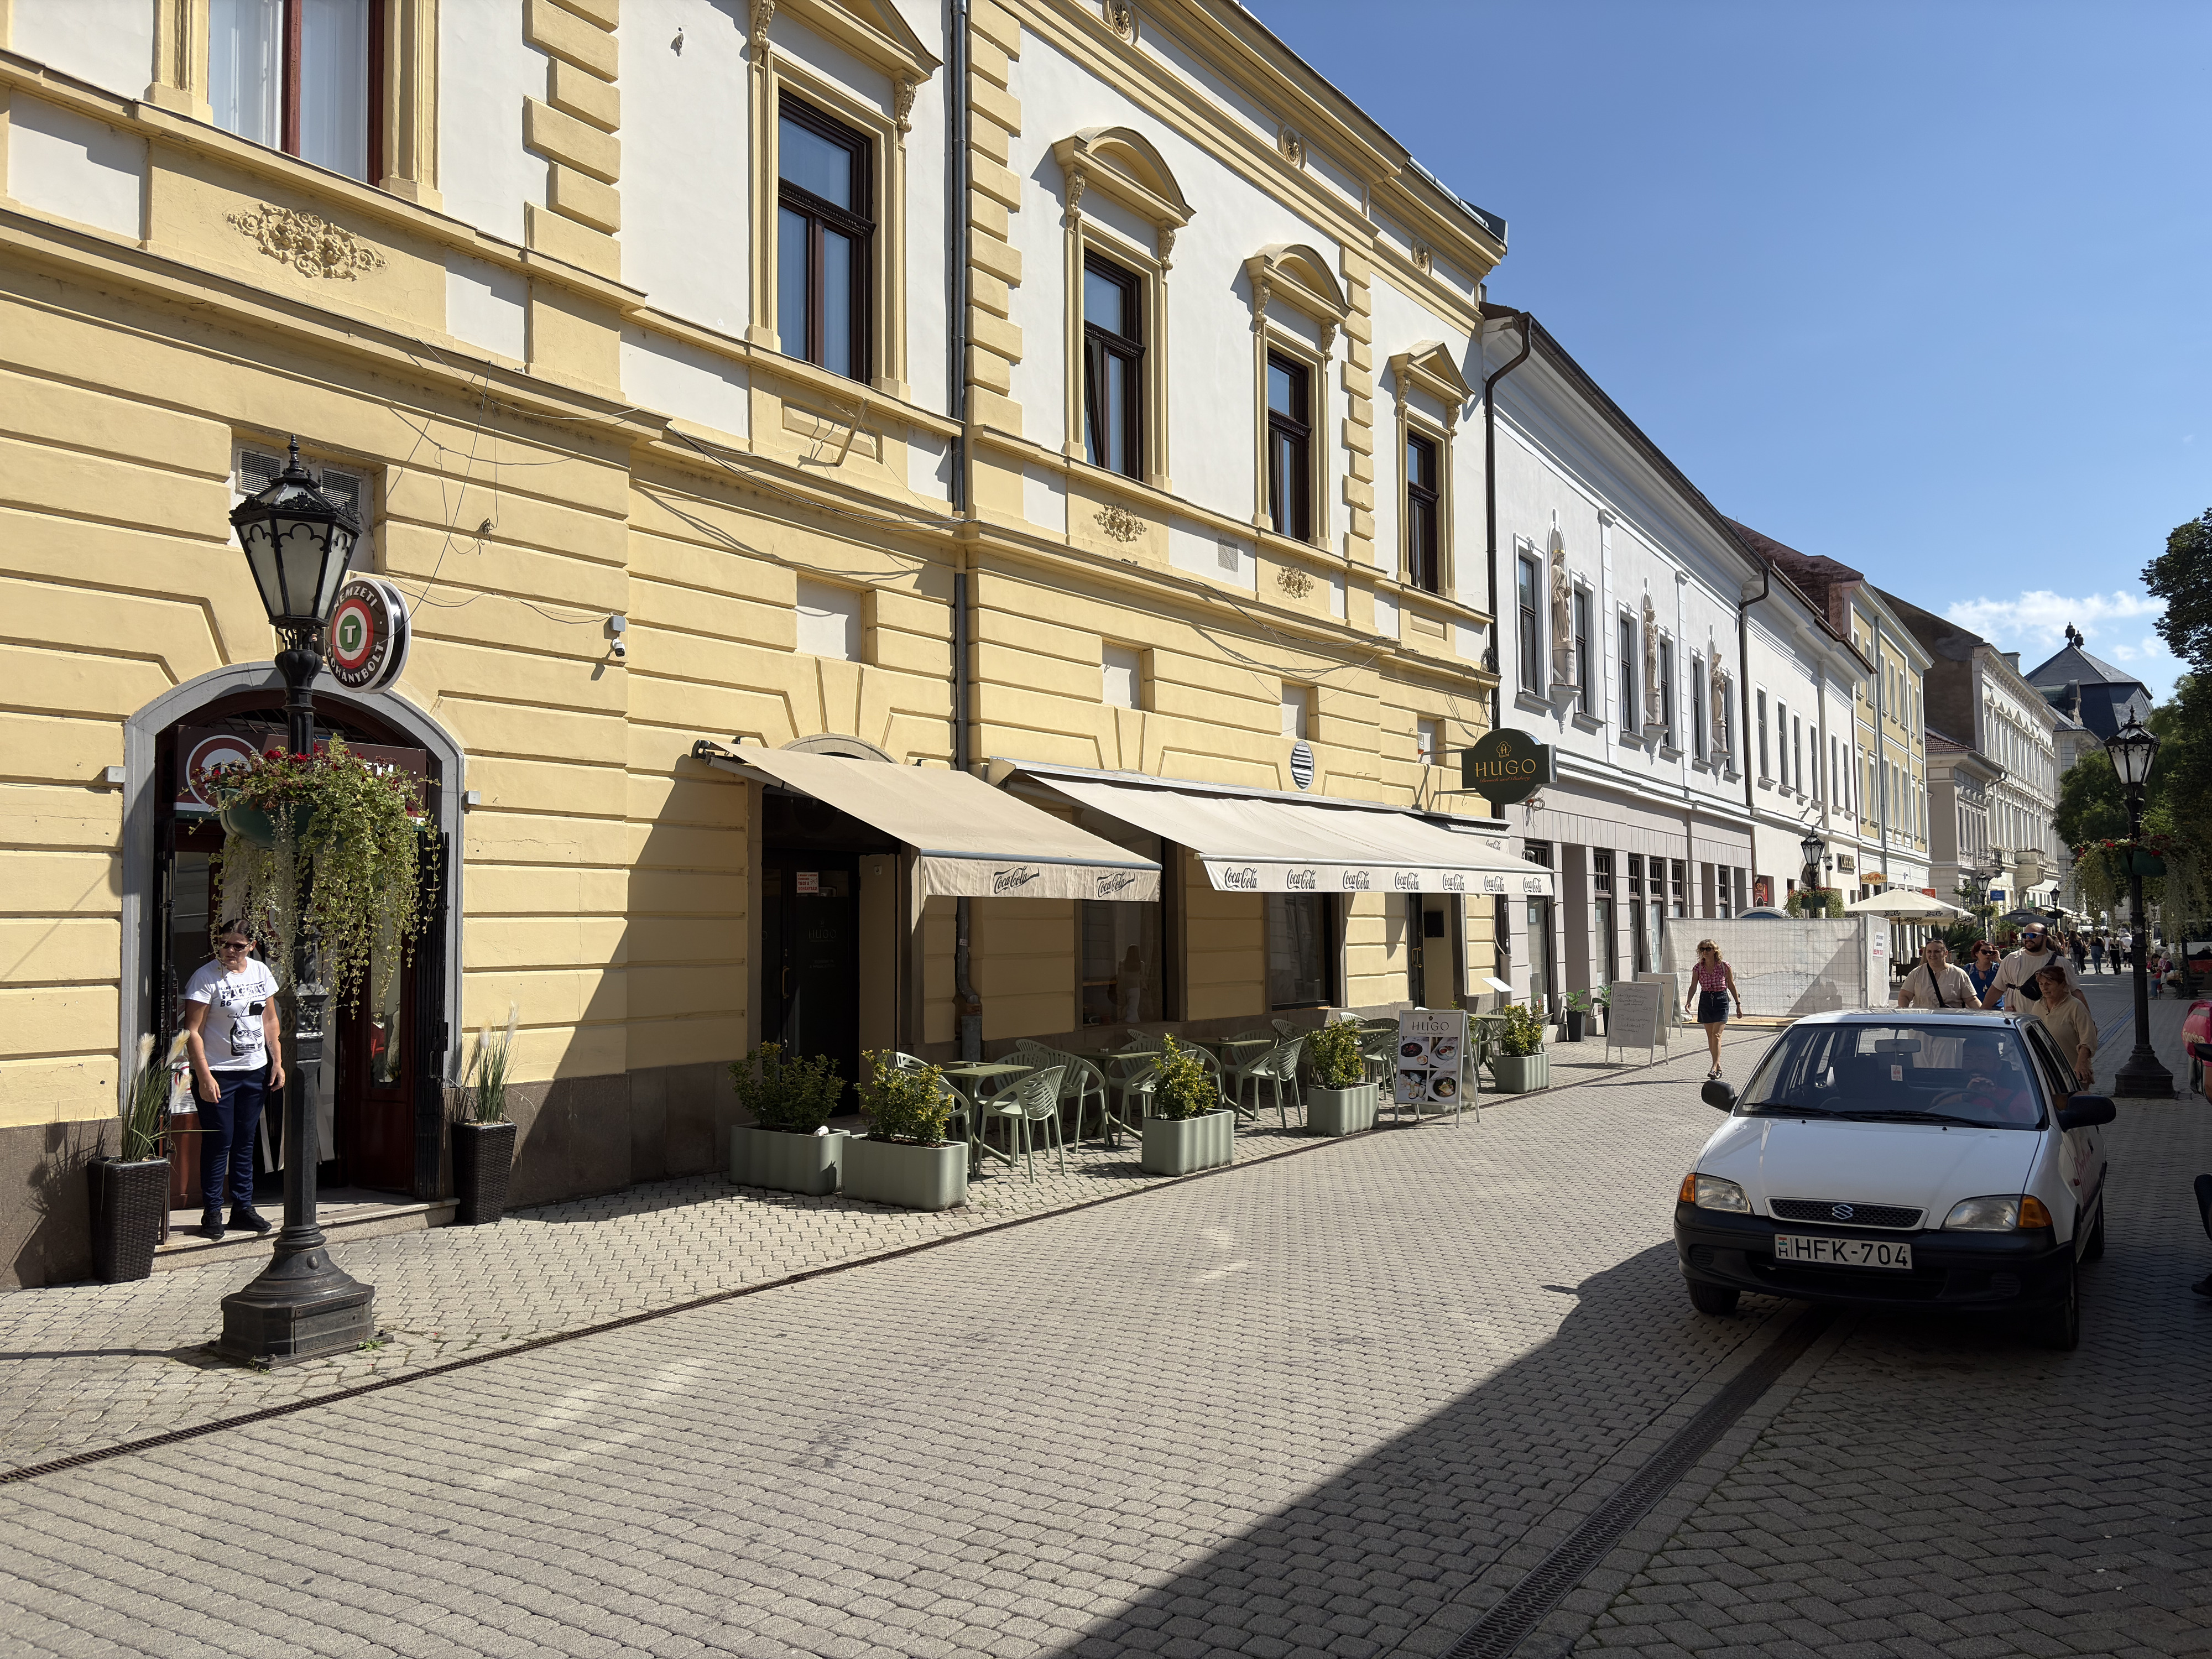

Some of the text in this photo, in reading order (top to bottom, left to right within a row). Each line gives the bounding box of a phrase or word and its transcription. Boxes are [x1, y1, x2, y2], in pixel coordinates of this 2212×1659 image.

[333, 586, 378, 612] NEMZETI
[345, 625, 356, 643] T
[327, 641, 384, 683] DOHÁNYBOLT
[1475, 759, 1536, 777] HUGO
[808, 929, 836, 938] HUGO
[1412, 1021, 1449, 1031] HUGO
[1778, 1238, 1908, 1266] H HFK-704
